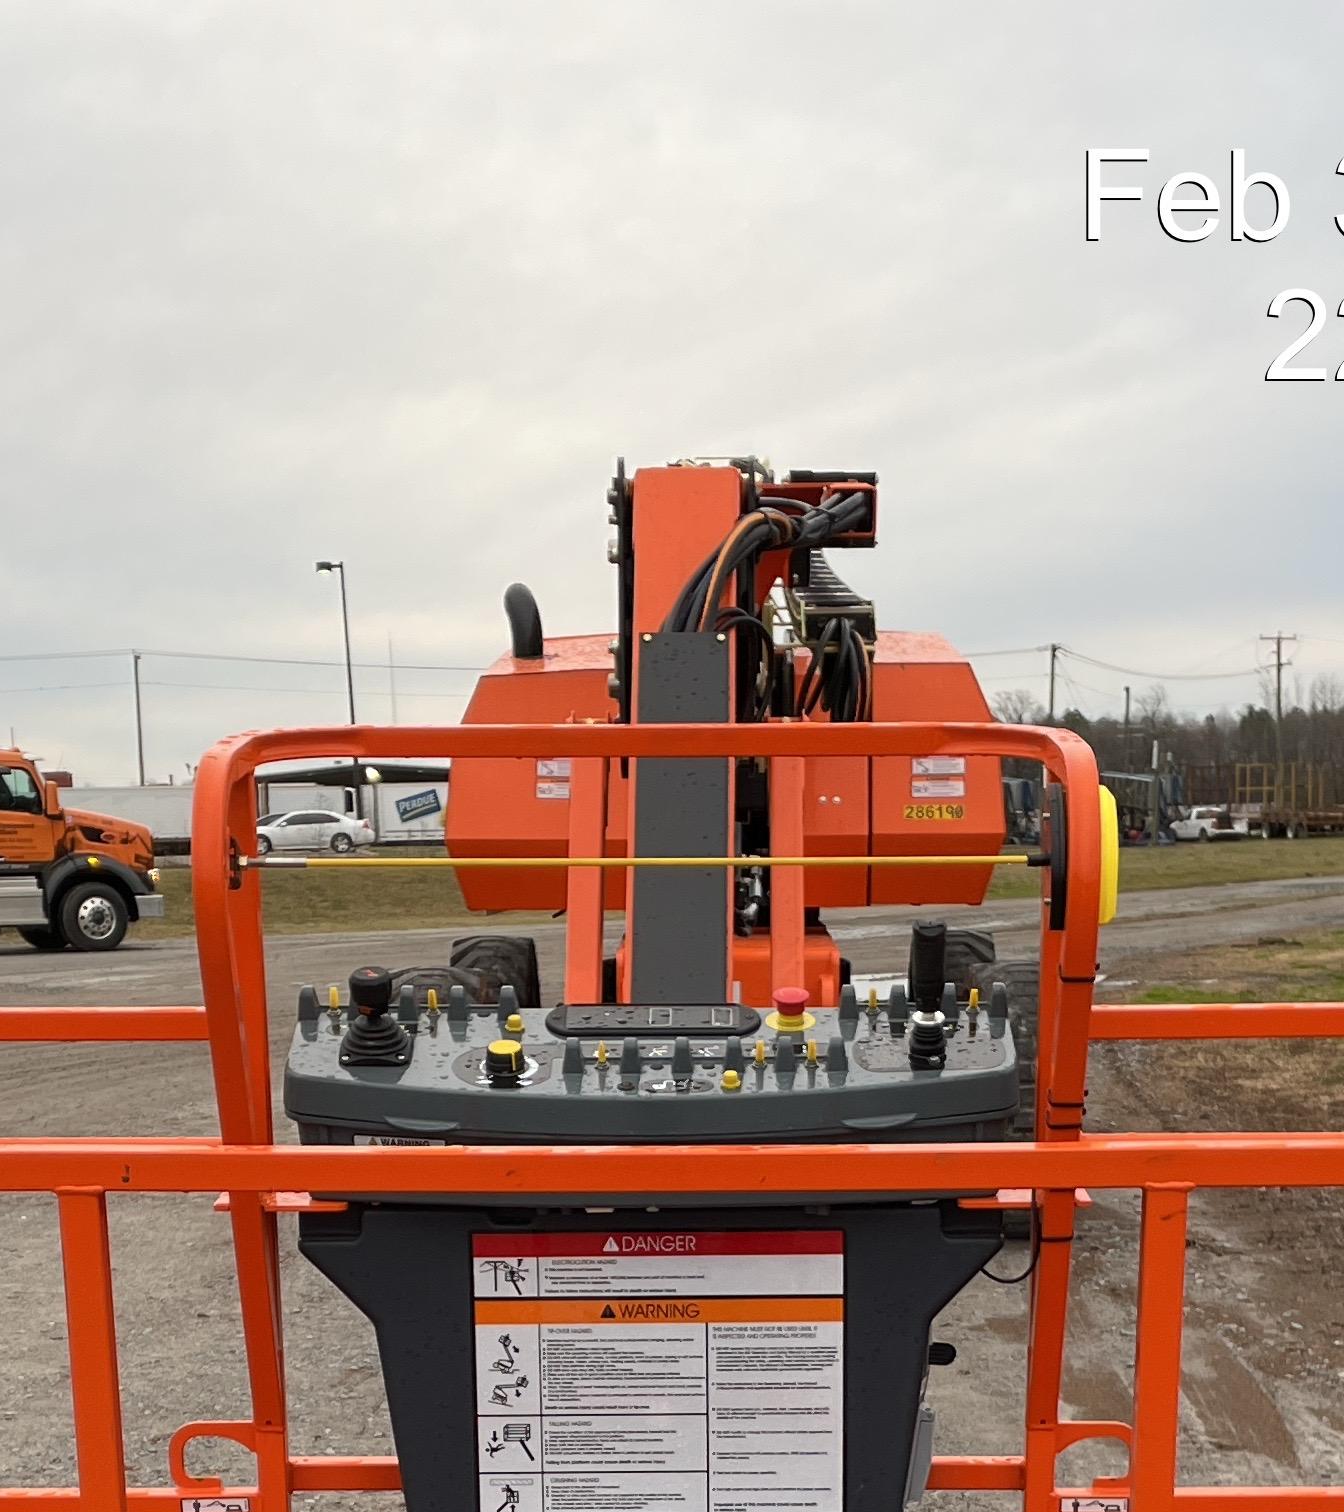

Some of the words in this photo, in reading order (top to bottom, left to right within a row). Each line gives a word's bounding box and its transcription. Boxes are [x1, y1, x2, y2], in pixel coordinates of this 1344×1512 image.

[399, 792, 436, 812] PERDUE
[622, 1235, 696, 1252] DANGER
[618, 1303, 700, 1319] WARNING
